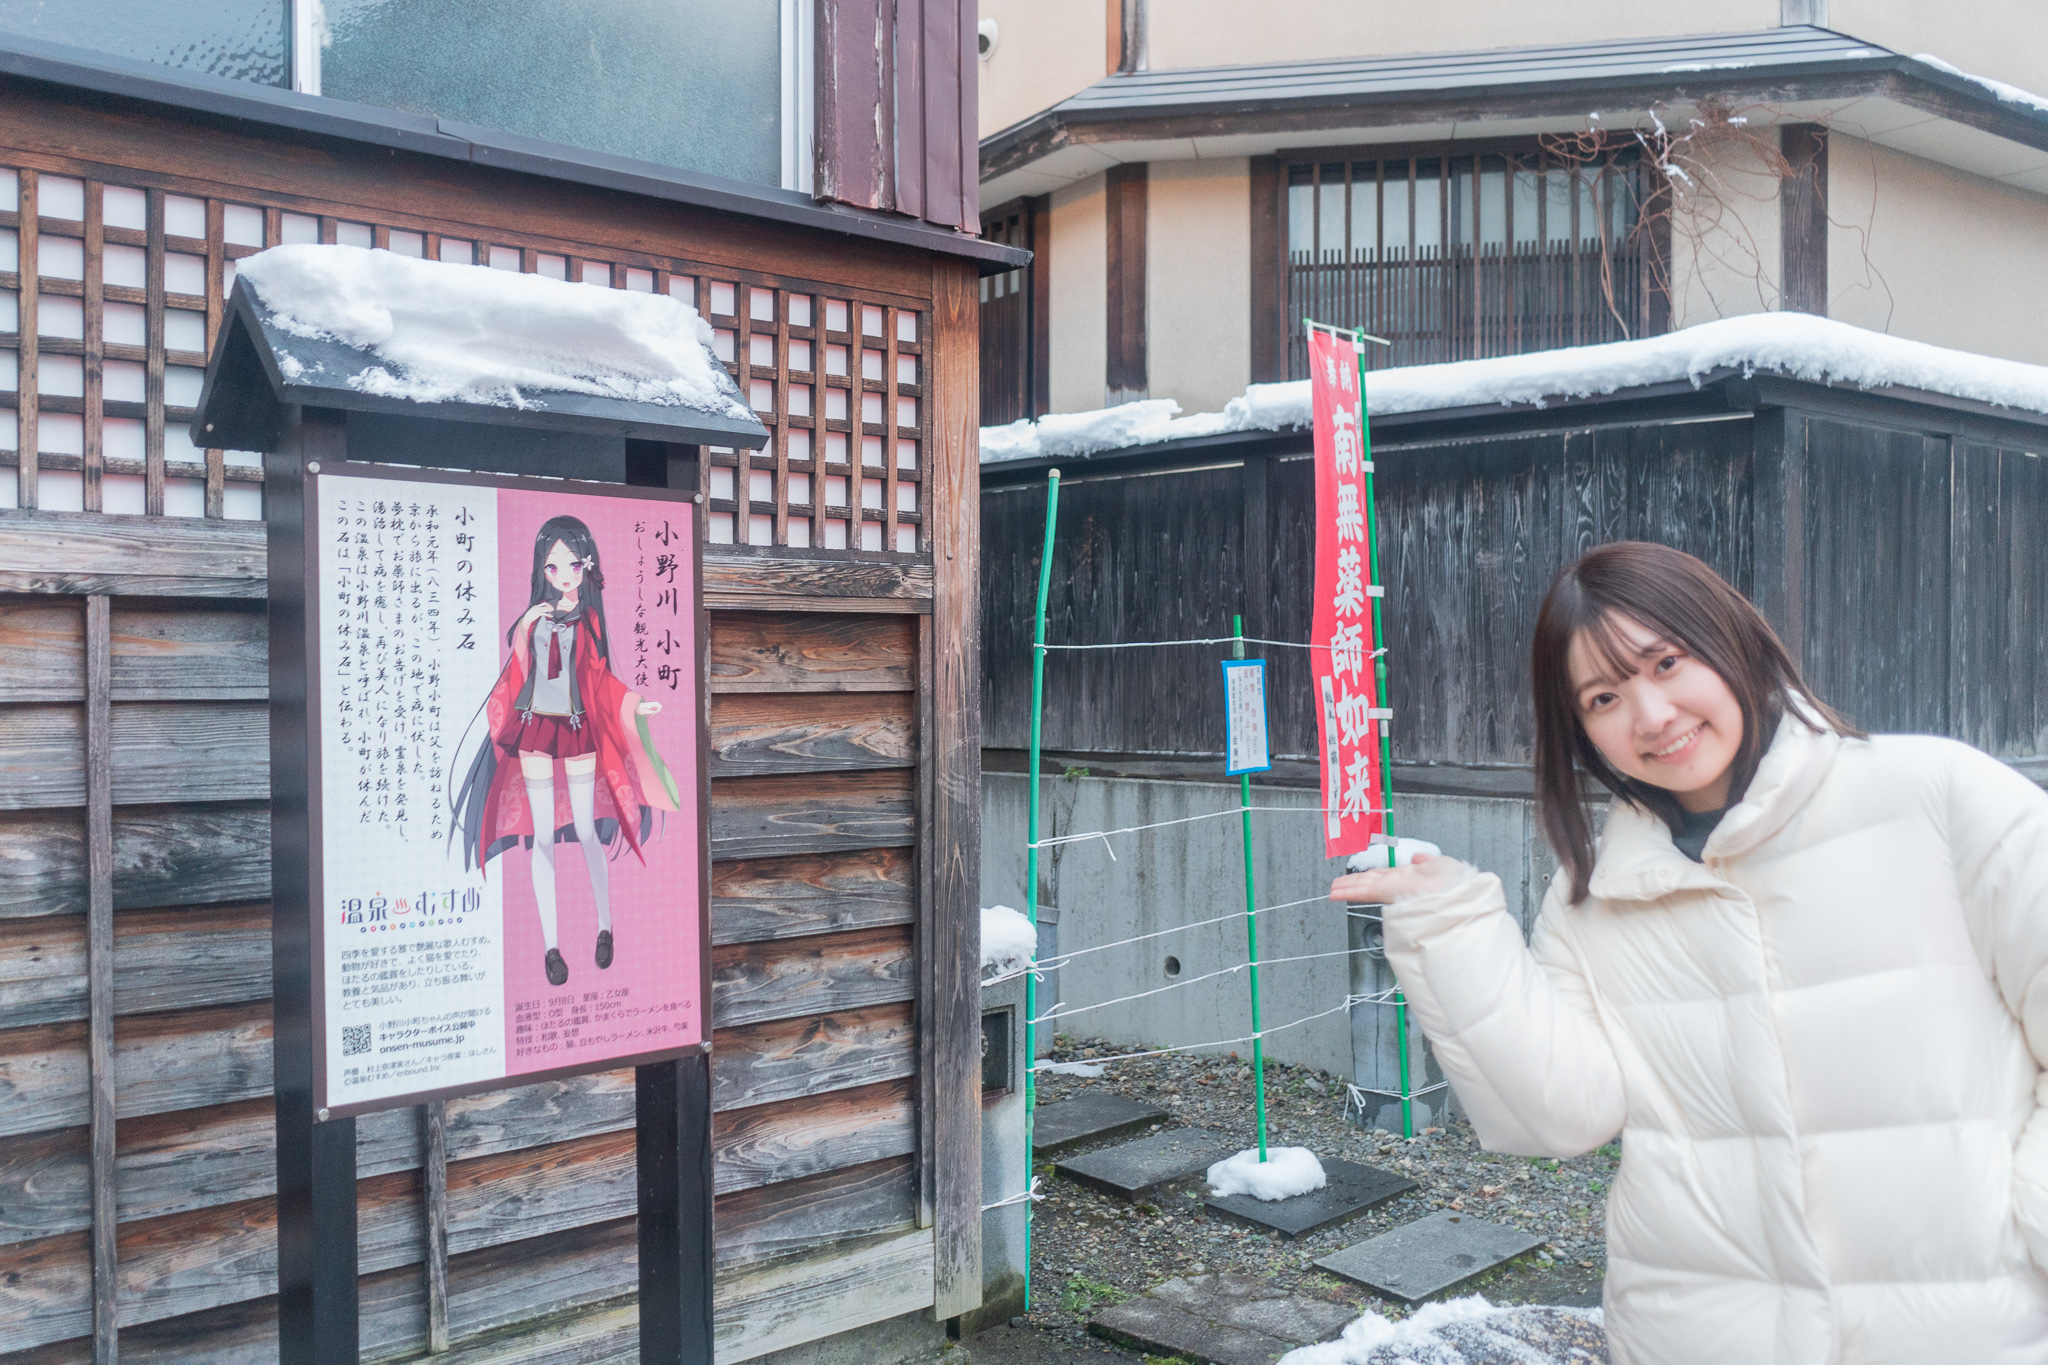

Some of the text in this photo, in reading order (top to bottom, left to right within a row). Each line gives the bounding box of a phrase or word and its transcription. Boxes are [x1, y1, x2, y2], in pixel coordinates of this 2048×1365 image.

[337, 500, 354, 752] この石は「小町の休み石」と伝わる。
[408, 503, 426, 781] 京から旅に出るが、この地で病に伏した。
[455, 505, 478, 652] 小町の休み石
[634, 521, 649, 687] おしょうしな観光大使
[355, 501, 373, 824] この温泉は小野川温泉と呼ばれ、小町が休んだ
[372, 500, 391, 830] 湯治して病を癒し、再び美人になり旅を続けた。
[343, 996, 402, 1010] とても美しい。
[379, 1034, 465, 1054] onsen-musume.jp
[380, 1020, 476, 1041] キャラクターボイス公開中
